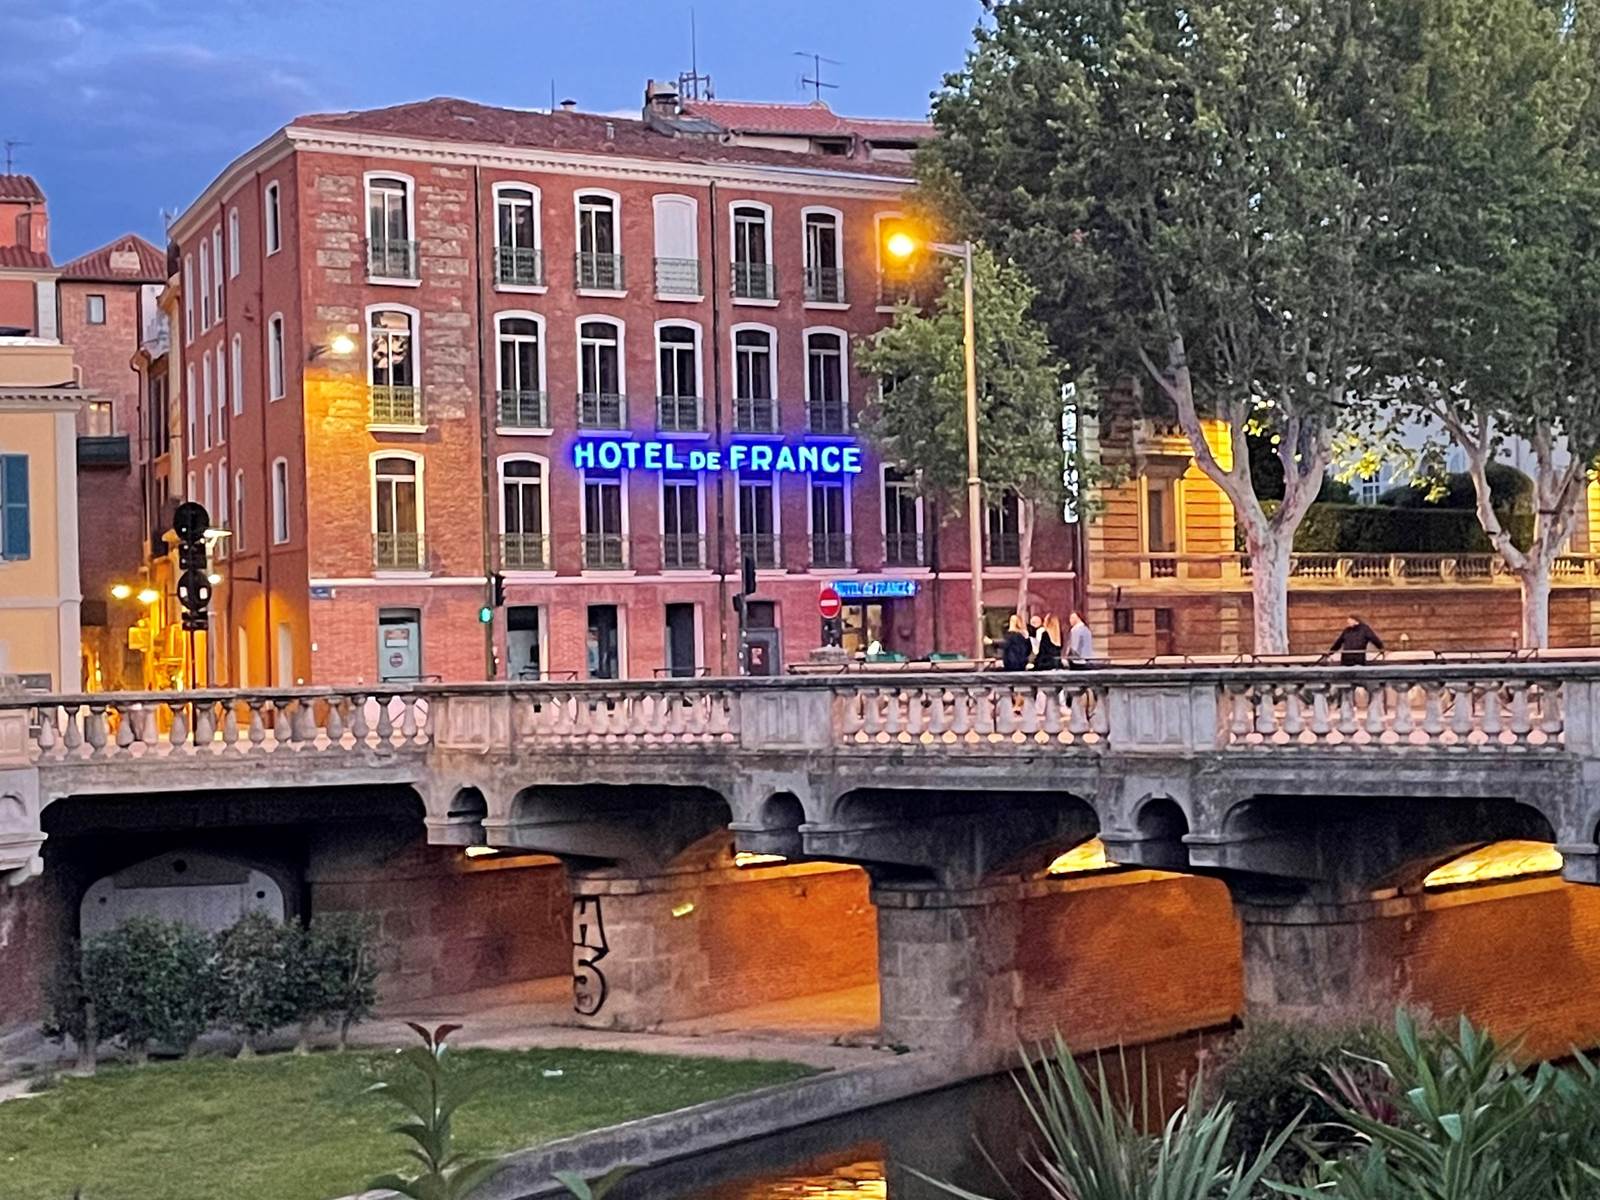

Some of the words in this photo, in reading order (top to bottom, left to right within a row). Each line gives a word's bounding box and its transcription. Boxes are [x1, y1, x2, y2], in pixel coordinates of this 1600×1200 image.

[573, 441, 684, 470] HOTEL
[689, 451, 721, 471] DE
[729, 445, 862, 473] FRANCE
